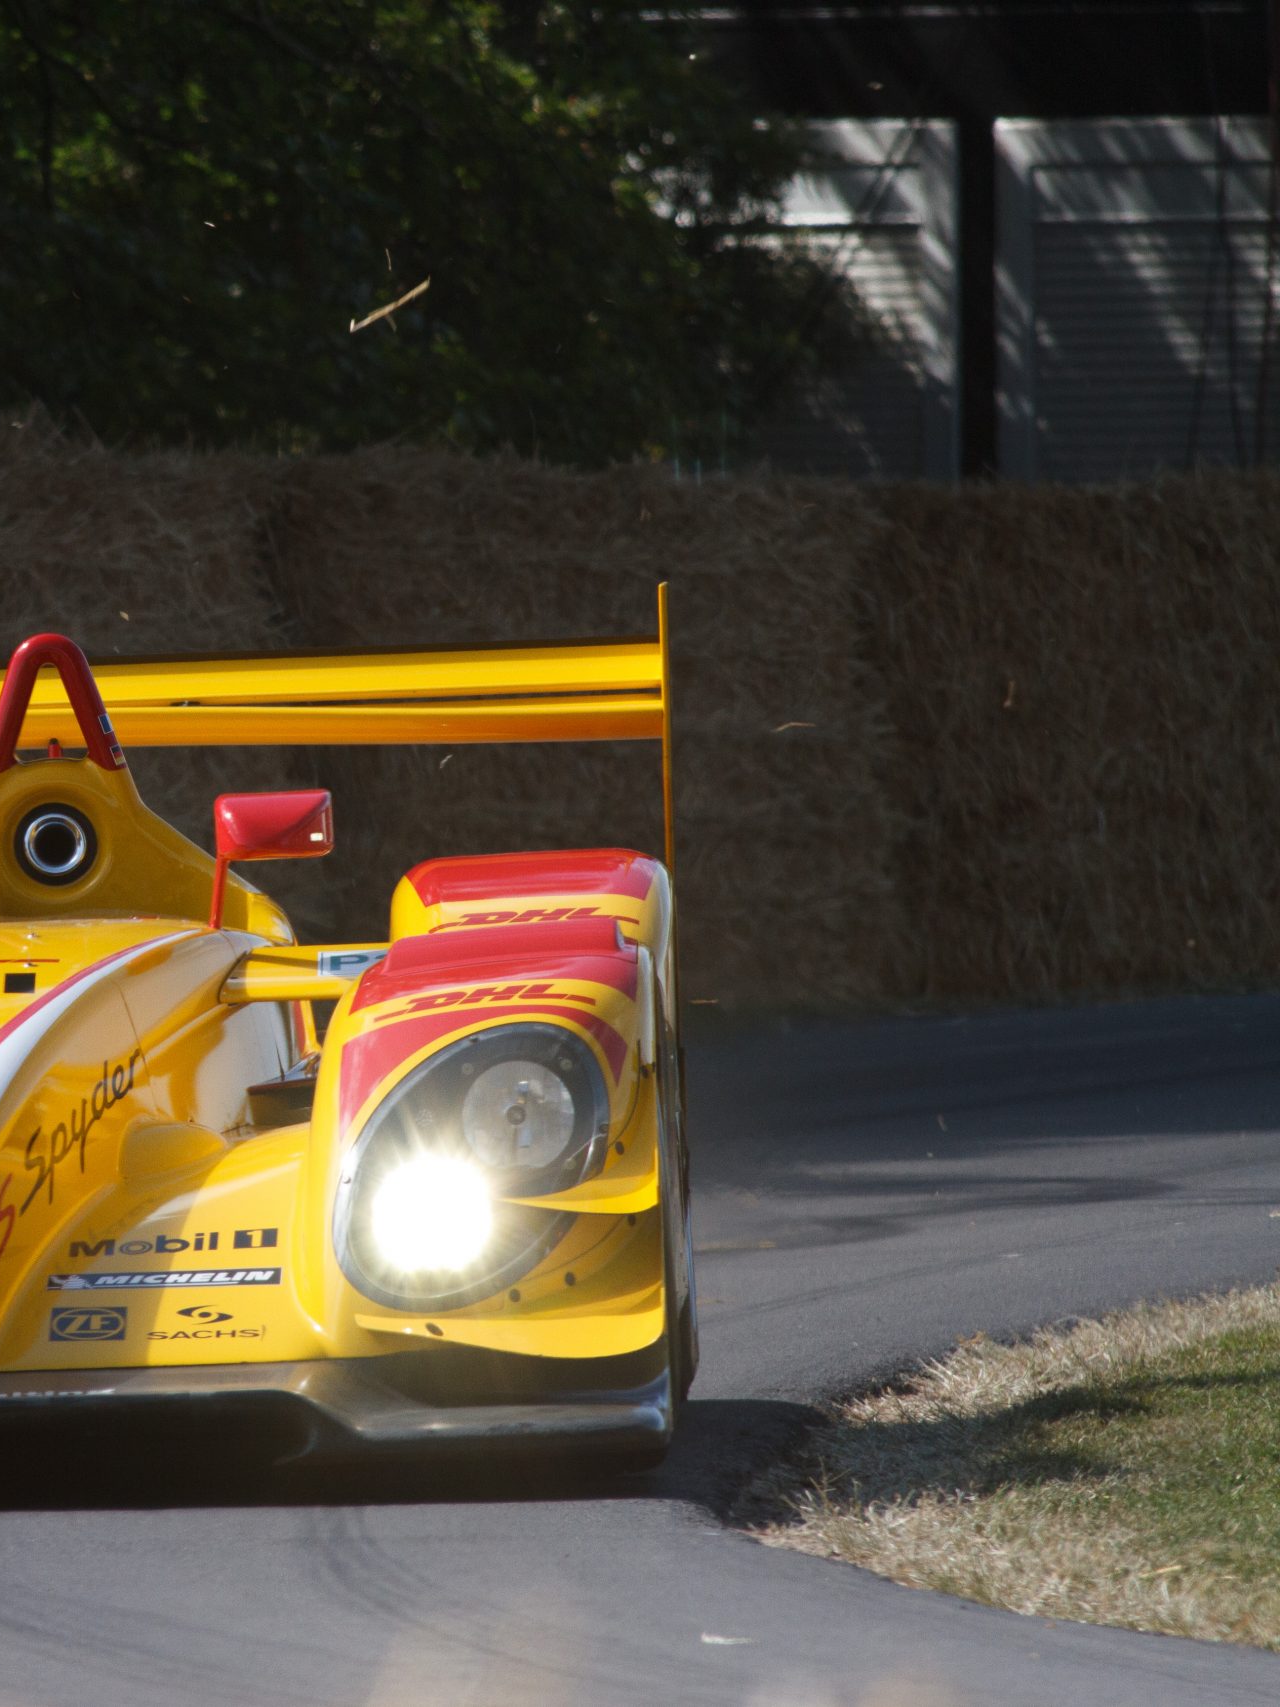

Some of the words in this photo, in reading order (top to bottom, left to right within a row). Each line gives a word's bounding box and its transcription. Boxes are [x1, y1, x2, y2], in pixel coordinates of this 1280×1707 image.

[458, 907, 614, 927] DHL
[405, 984, 568, 1013] DHL
[19, 1048, 140, 1218] Spyder
[69, 1231, 219, 1258] Mobil
[94, 1270, 275, 1287] MICHELIN
[62, 1313, 114, 1335] ZF
[146, 1328, 261, 1341] SACHS
